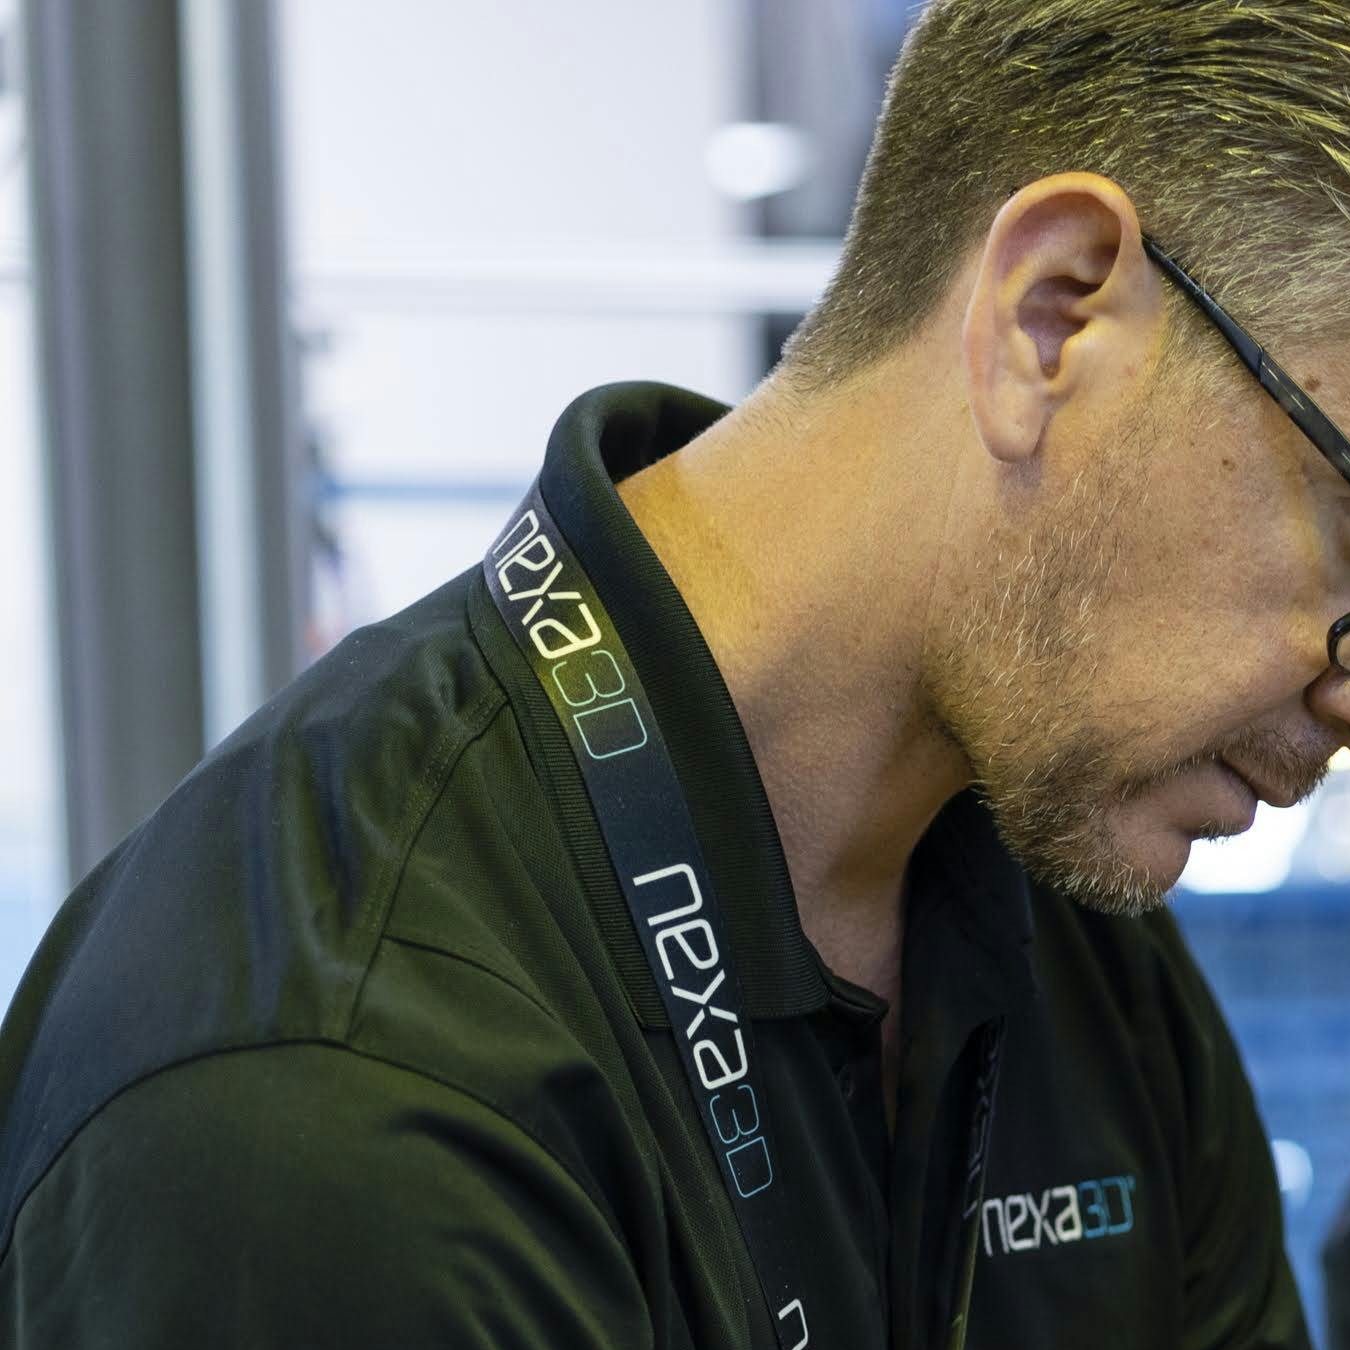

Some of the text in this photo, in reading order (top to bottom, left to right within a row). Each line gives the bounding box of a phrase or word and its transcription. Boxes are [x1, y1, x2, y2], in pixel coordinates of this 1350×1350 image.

[492, 509, 648, 760] nexa3D
[632, 862, 773, 1199] nexa3D
[982, 1175, 1134, 1257] nexa3D
